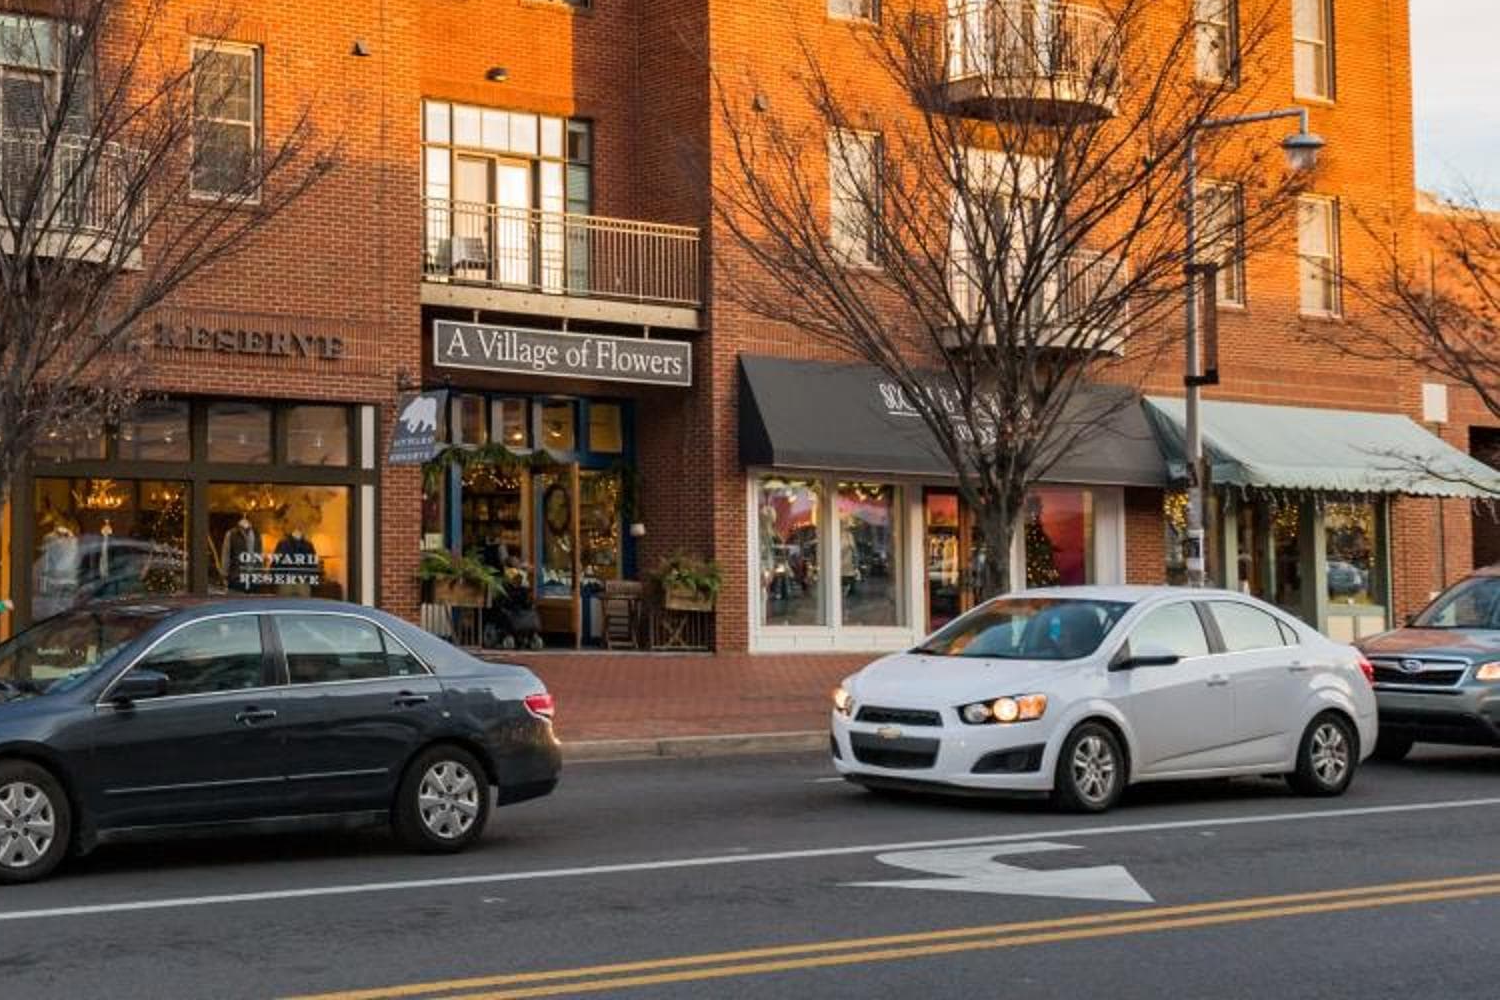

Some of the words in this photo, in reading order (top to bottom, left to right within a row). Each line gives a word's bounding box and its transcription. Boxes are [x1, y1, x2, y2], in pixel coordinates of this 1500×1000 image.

[447, 327, 470, 358] A
[476, 329, 559, 371] Village
[565, 338, 590, 367] of
[595, 339, 682, 376] Flowers
[239, 552, 319, 566] ONWARD
[239, 573, 320, 586] RESERVE
